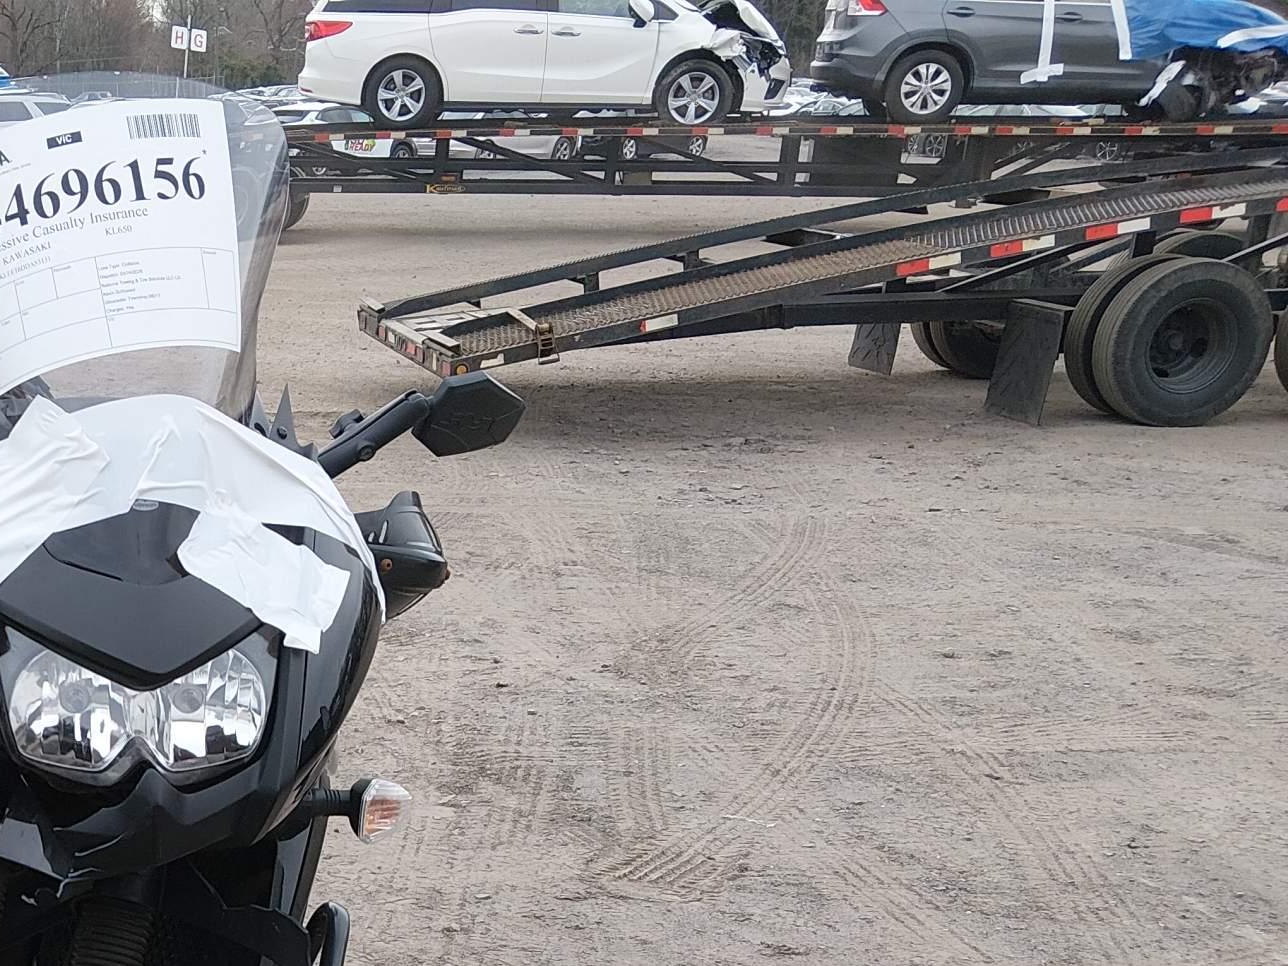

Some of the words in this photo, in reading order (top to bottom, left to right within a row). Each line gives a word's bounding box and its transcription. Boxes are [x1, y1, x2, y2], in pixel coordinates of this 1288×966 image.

[175, 30, 184, 45] H
[194, 33, 204, 48] G
[55, 134, 73, 145] VIC
[32, 216, 86, 239] Casualty
[90, 206, 149, 224] Insurance
[2, 241, 52, 265] KAWASAKI
[104, 225, 133, 236] KL650
